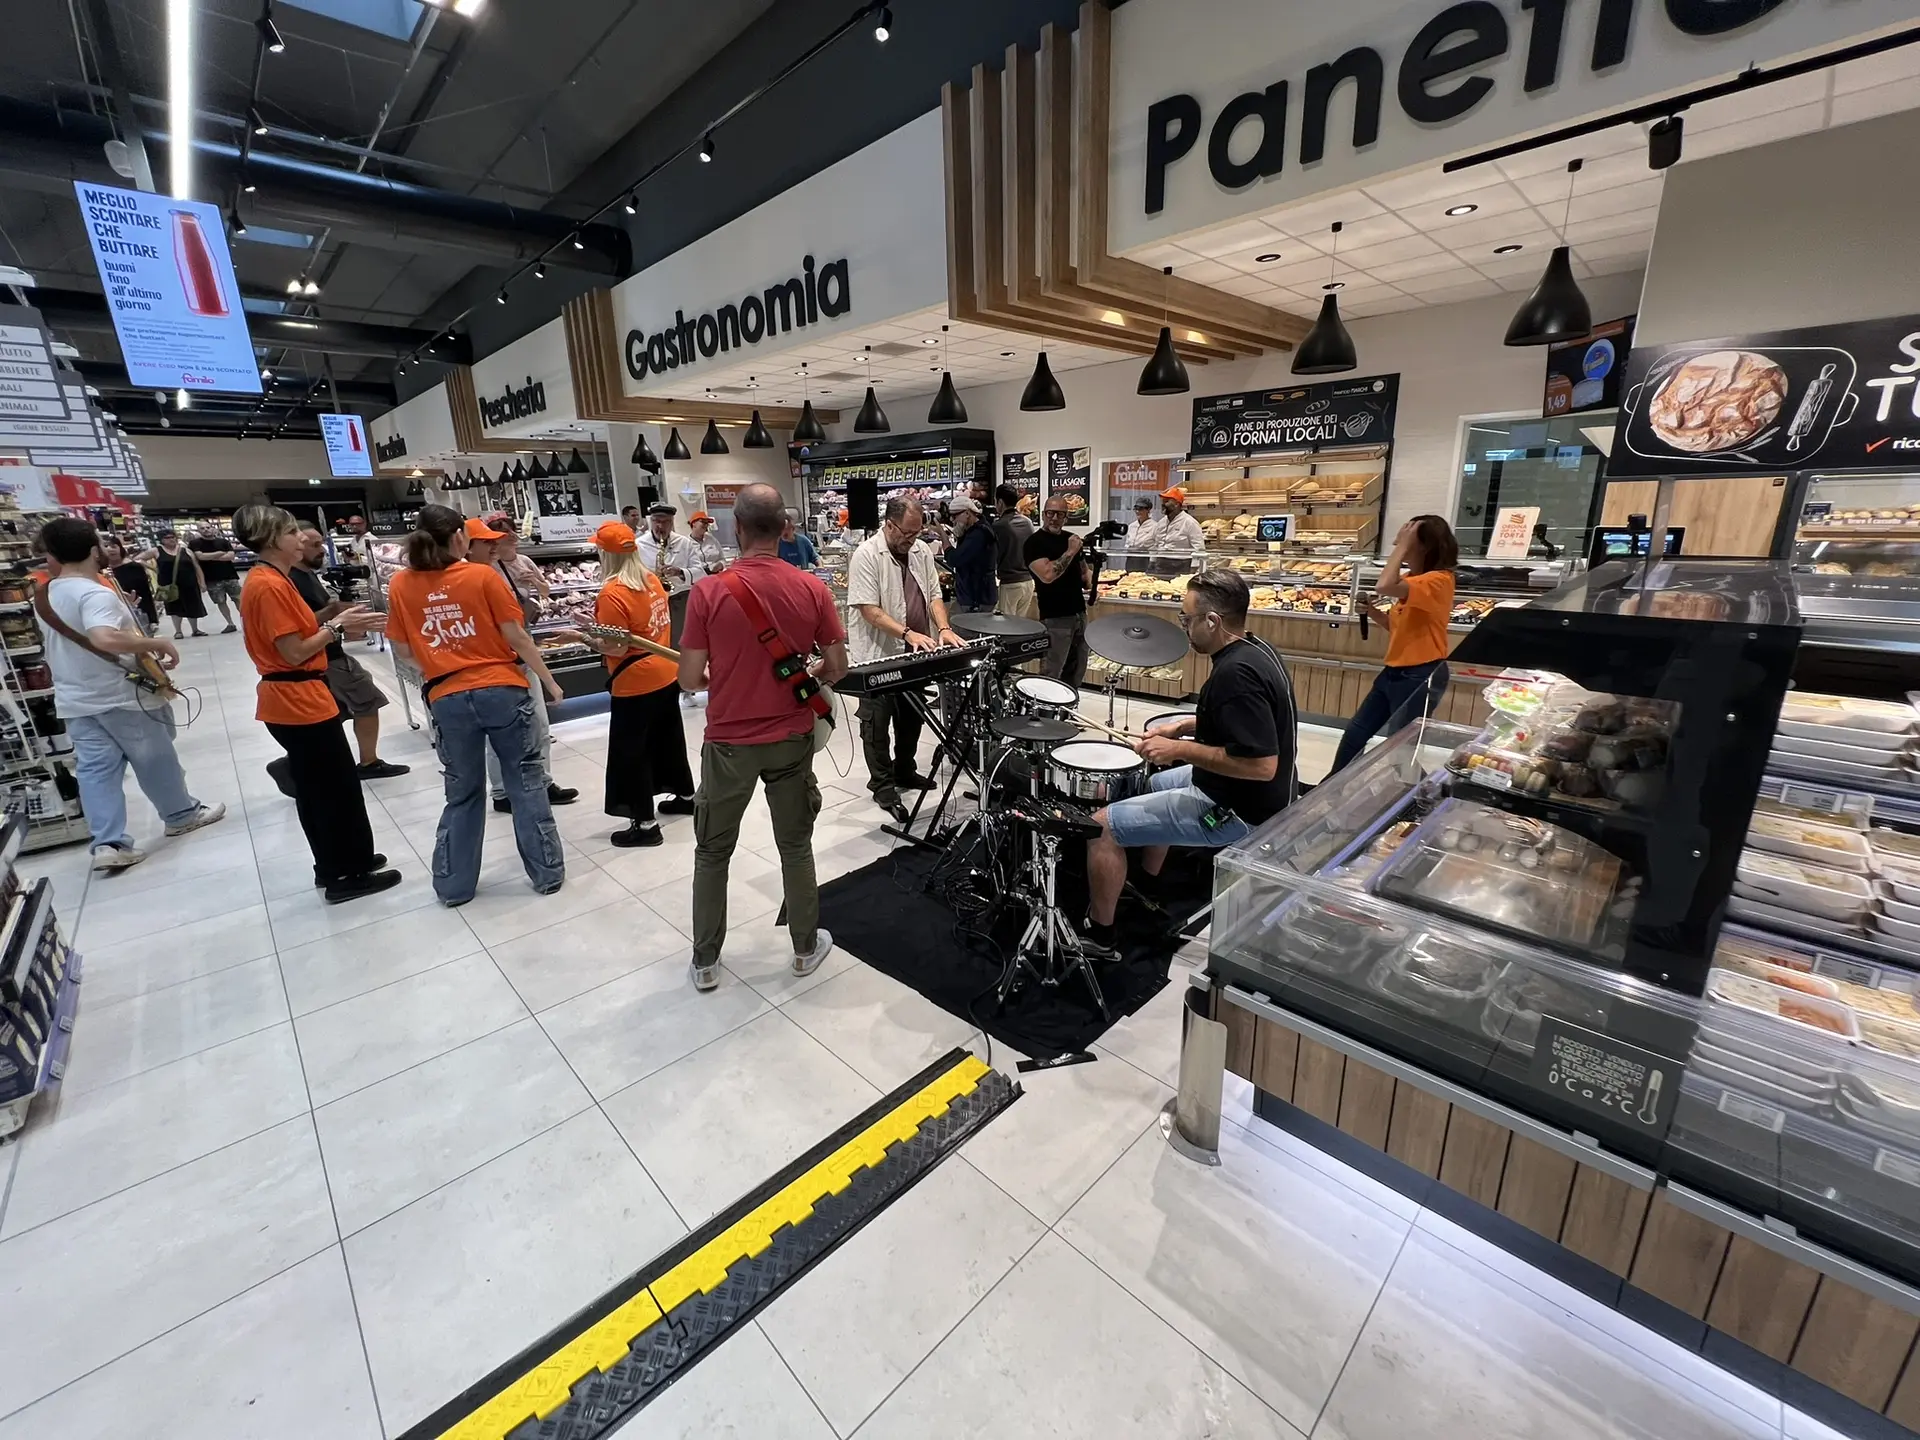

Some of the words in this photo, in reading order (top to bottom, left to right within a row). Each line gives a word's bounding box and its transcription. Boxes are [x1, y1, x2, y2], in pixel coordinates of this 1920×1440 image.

[83, 189, 137, 211] MEGLIO
[89, 206, 161, 230] SCONTARE
[93, 222, 123, 239] CHE
[98, 238, 159, 260] BUTTARE
[104, 259, 136, 273] buoni
[107, 272, 130, 285] fino
[112, 285, 162, 300] all'ultimo
[115, 298, 151, 311] giorno
[626, 255, 850, 380] Gastronomia
[478, 375, 547, 429] Pescheria
[1547, 394, 1566, 411] 1,49
[1234, 422, 1254, 432] PANE
[1256, 421, 1264, 430] DI
[1266, 416, 1322, 429] PRODUZIONE
[1324, 414, 1338, 424] DEI
[1233, 429, 1281, 446] FORNAI
[1286, 424, 1337, 442] LOCALI
[1051, 478, 1059, 487] LE
[1060, 477, 1086, 486] LASAGNE
[1114, 463, 1158, 485] famila
[421, 616, 476, 648] Show
[876, 670, 903, 684] YAMAHA
[1563, 1044, 1600, 1064] QUESTO
[1602, 1059, 1644, 1080] REPARTO
[1551, 1062, 1558, 1071] A
[1560, 1066, 1620, 1094] TEMPERATURA
[1584, 1060, 1642, 1087] CONSERVATI
[1581, 1087, 1594, 1099] a
